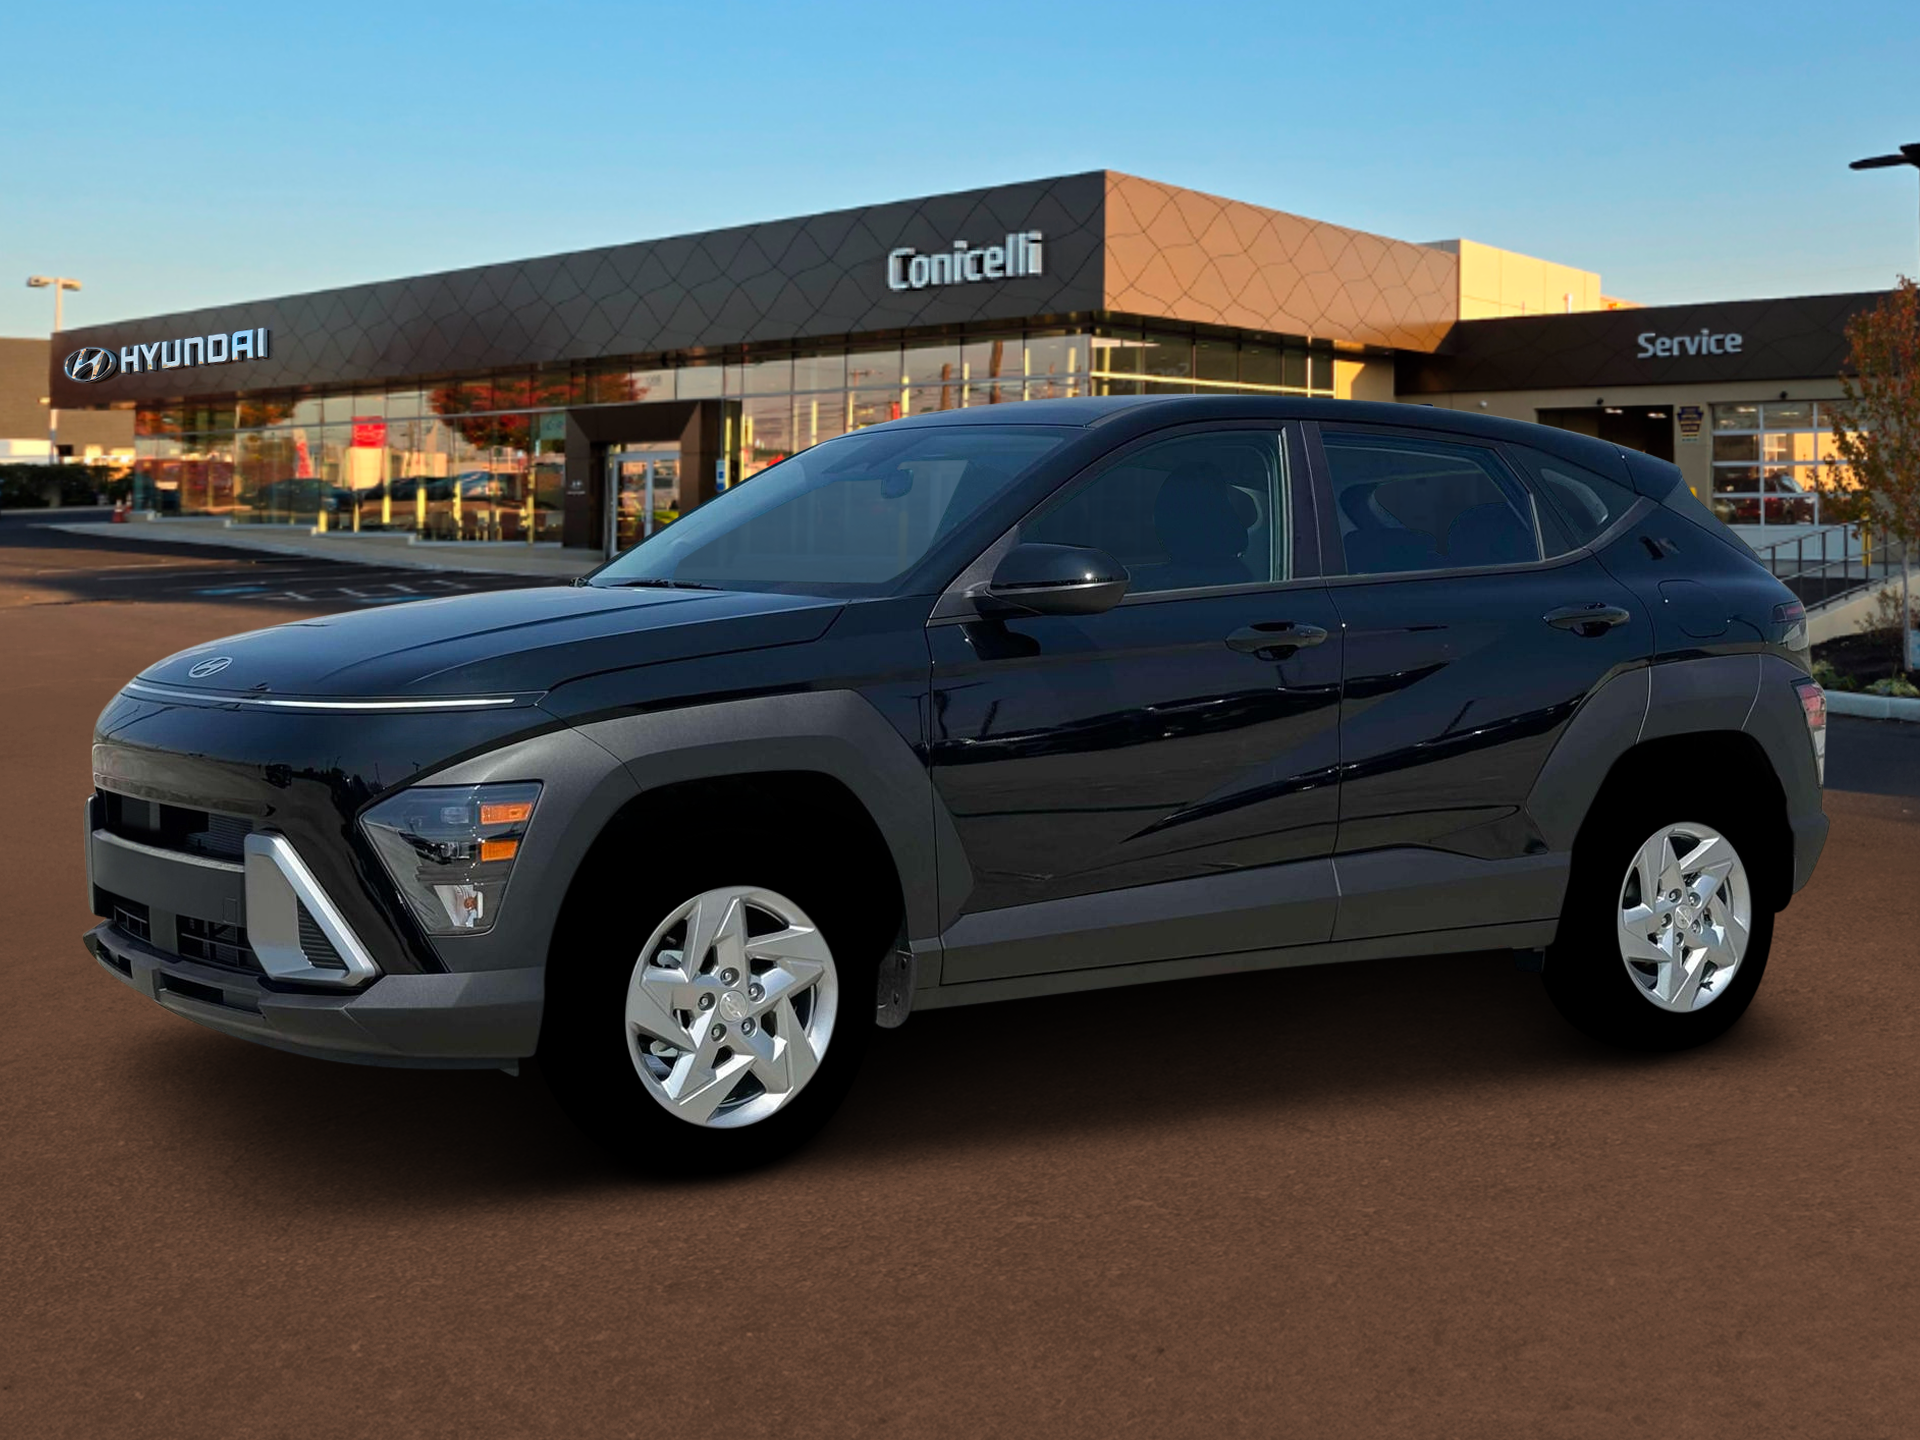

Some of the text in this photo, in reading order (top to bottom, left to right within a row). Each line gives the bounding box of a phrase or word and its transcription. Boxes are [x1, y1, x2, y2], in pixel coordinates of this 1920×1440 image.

[888, 231, 1042, 290] Conicelli
[120, 328, 270, 373] HYUNDAI
[1637, 328, 1743, 359] Service
